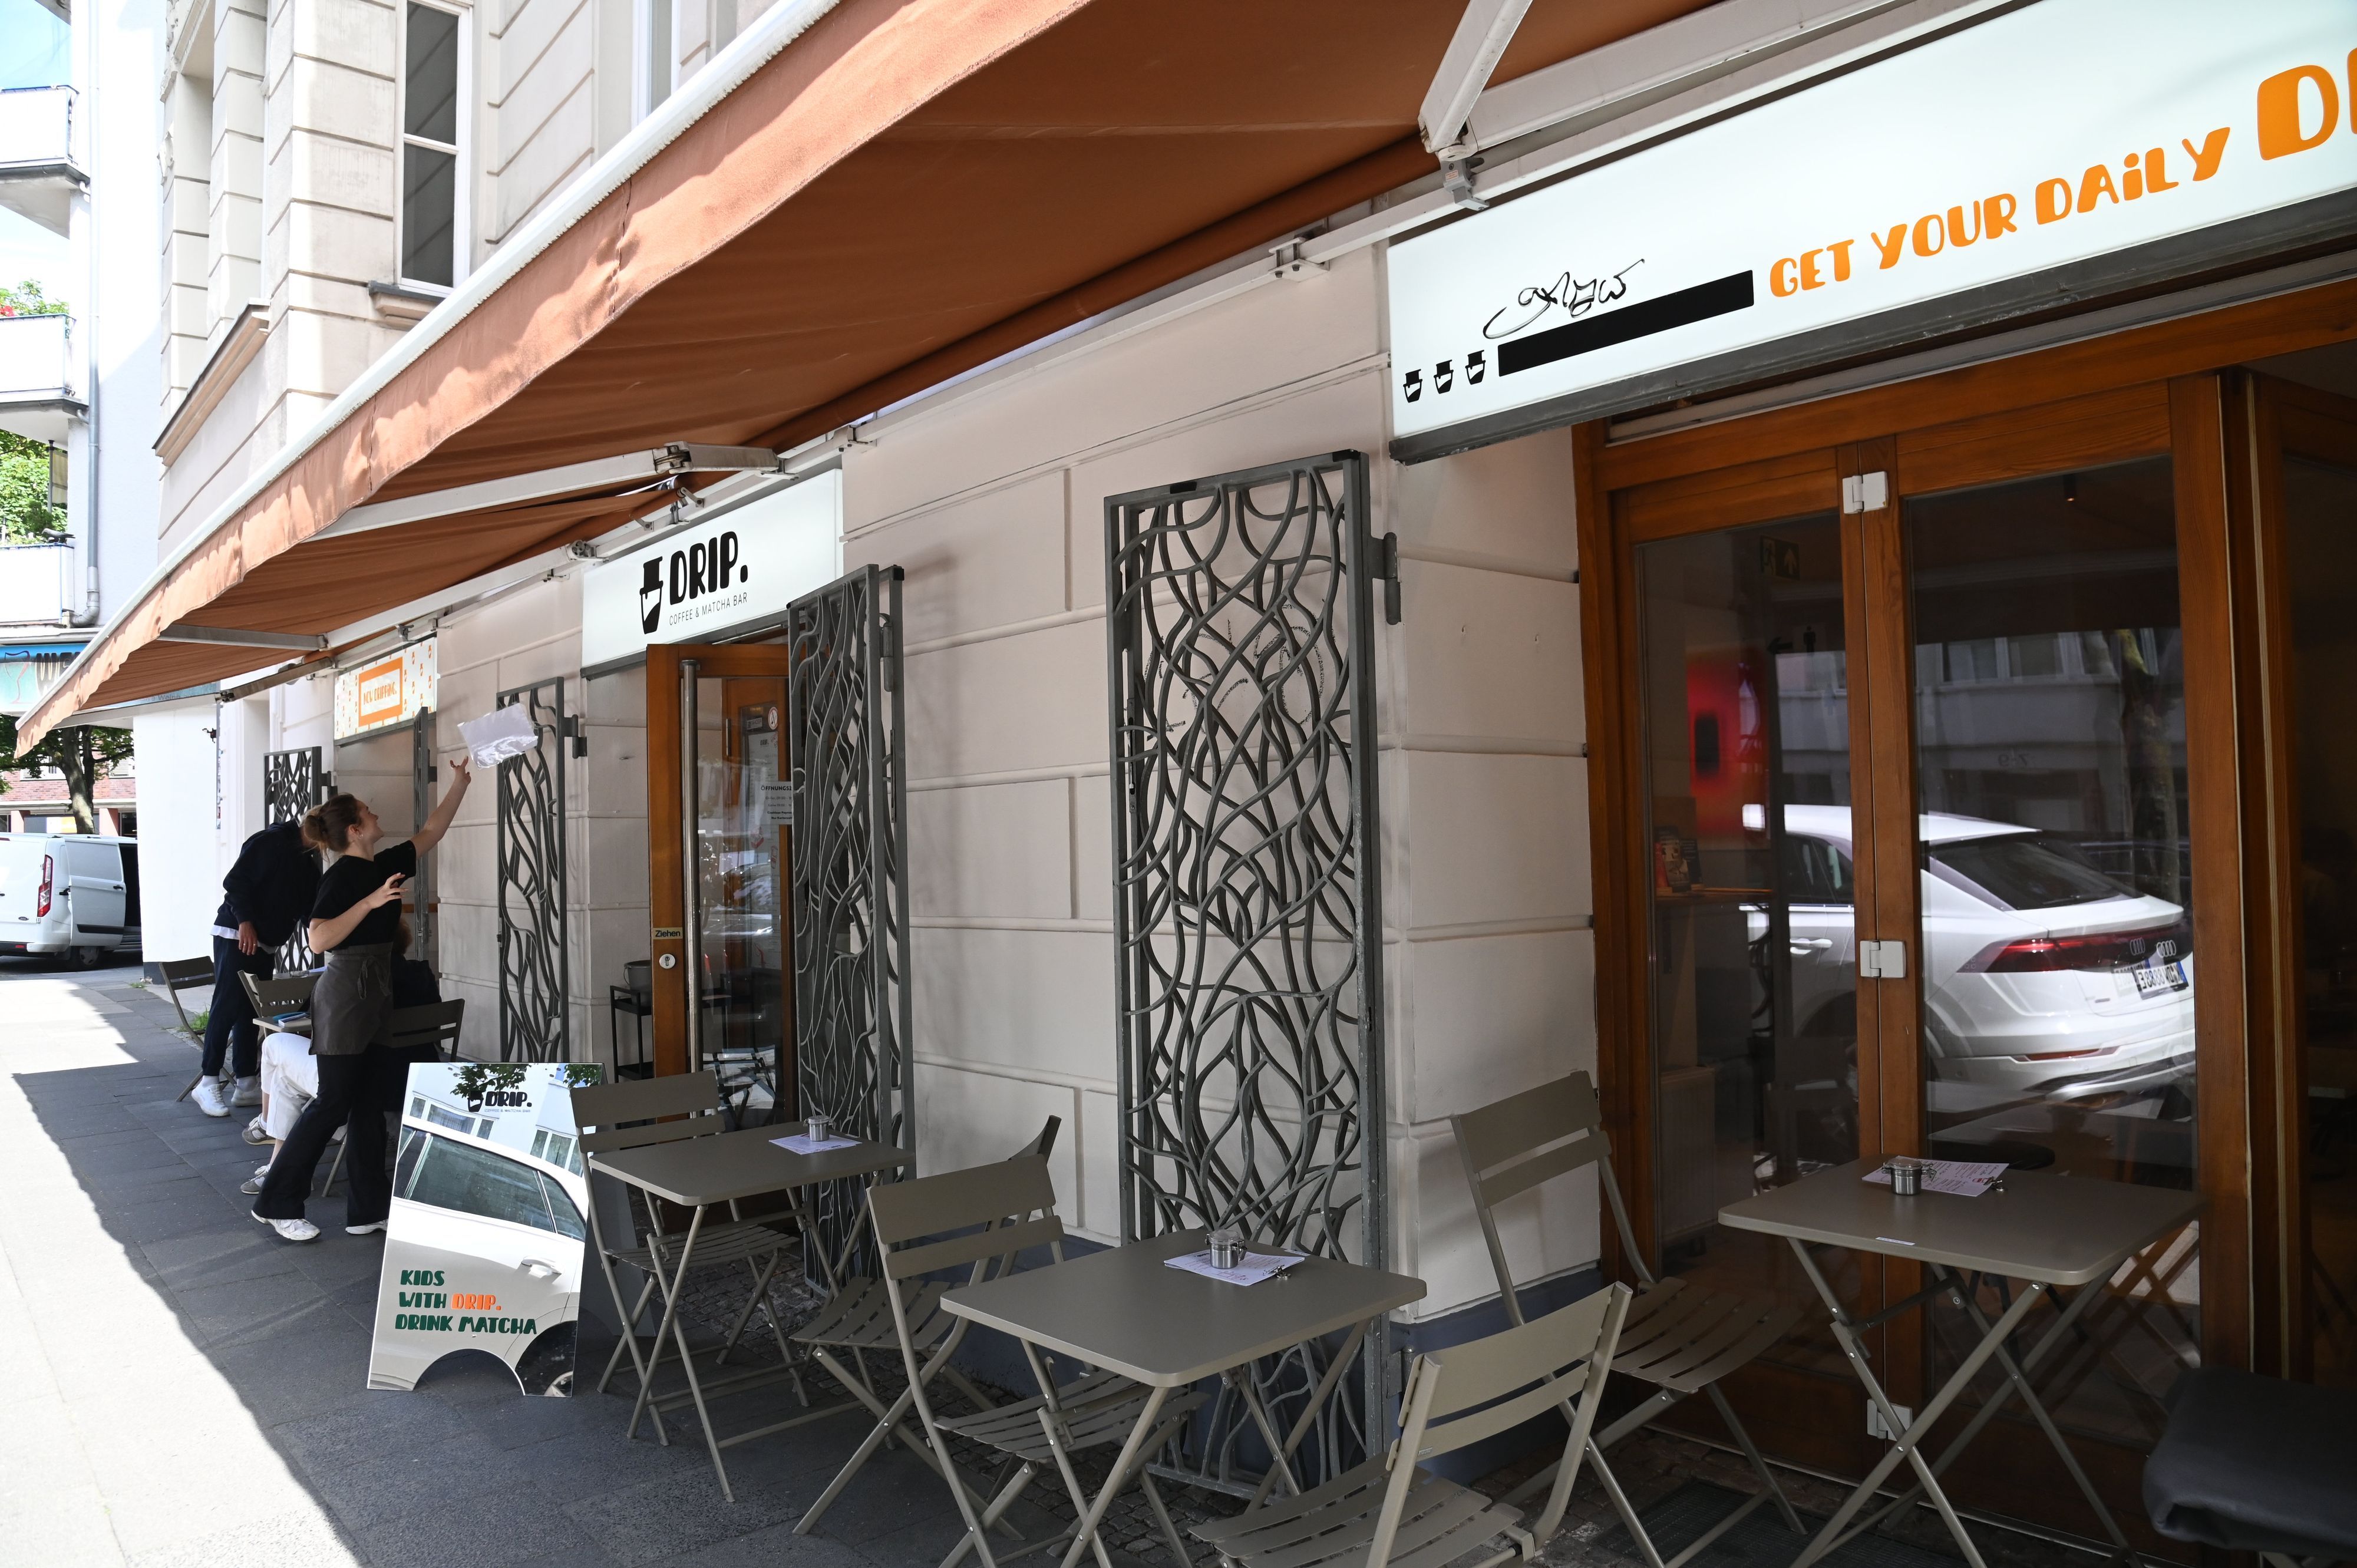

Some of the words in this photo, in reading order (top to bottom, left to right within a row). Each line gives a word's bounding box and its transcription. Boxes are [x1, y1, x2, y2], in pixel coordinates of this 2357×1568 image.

[1770, 239, 1854, 298] GET
[1870, 193, 2018, 270] YOUR
[2257, 47, 2357, 161] D
[669, 531, 748, 606] DRIP.
[669, 609, 693, 626] COFFEE
[695, 607, 699, 618] &
[702, 598, 731, 616] MATCHA
[733, 592, 748, 606] BAR
[363, 690, 374, 705] NOW
[485, 1091, 532, 1107] DRIP.
[400, 1269, 445, 1286] KIDS
[399, 1291, 447, 1309] WITH
[451, 1293, 501, 1311] DRIP.
[395, 1313, 453, 1332] DRINK
[458, 1316, 537, 1335] MATCHA
